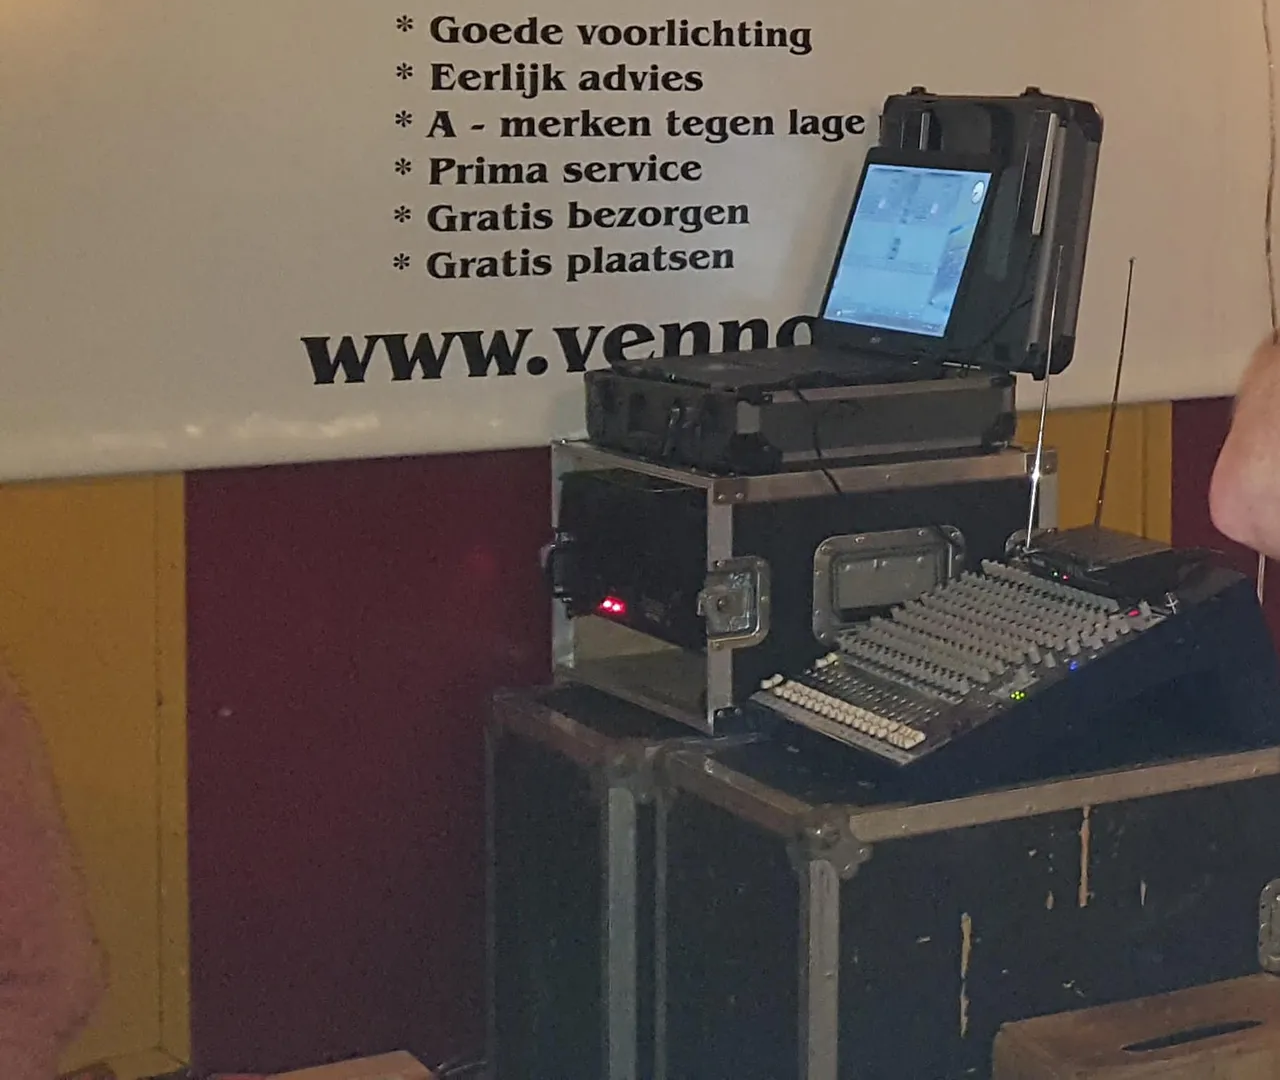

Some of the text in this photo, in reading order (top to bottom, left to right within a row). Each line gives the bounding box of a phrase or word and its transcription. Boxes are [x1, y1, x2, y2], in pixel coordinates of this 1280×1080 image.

[429, 14, 813, 56] Goede voorlichting
[430, 62, 704, 100] Eerlijk advies
[426, 110, 457, 139] A
[499, 109, 652, 138] merken
[665, 110, 775, 144] tegen
[788, 108, 866, 143] lage
[428, 153, 703, 186] Prima service
[426, 200, 750, 234] Gratis bezorgen
[426, 245, 735, 283] Gratis plaatsen
